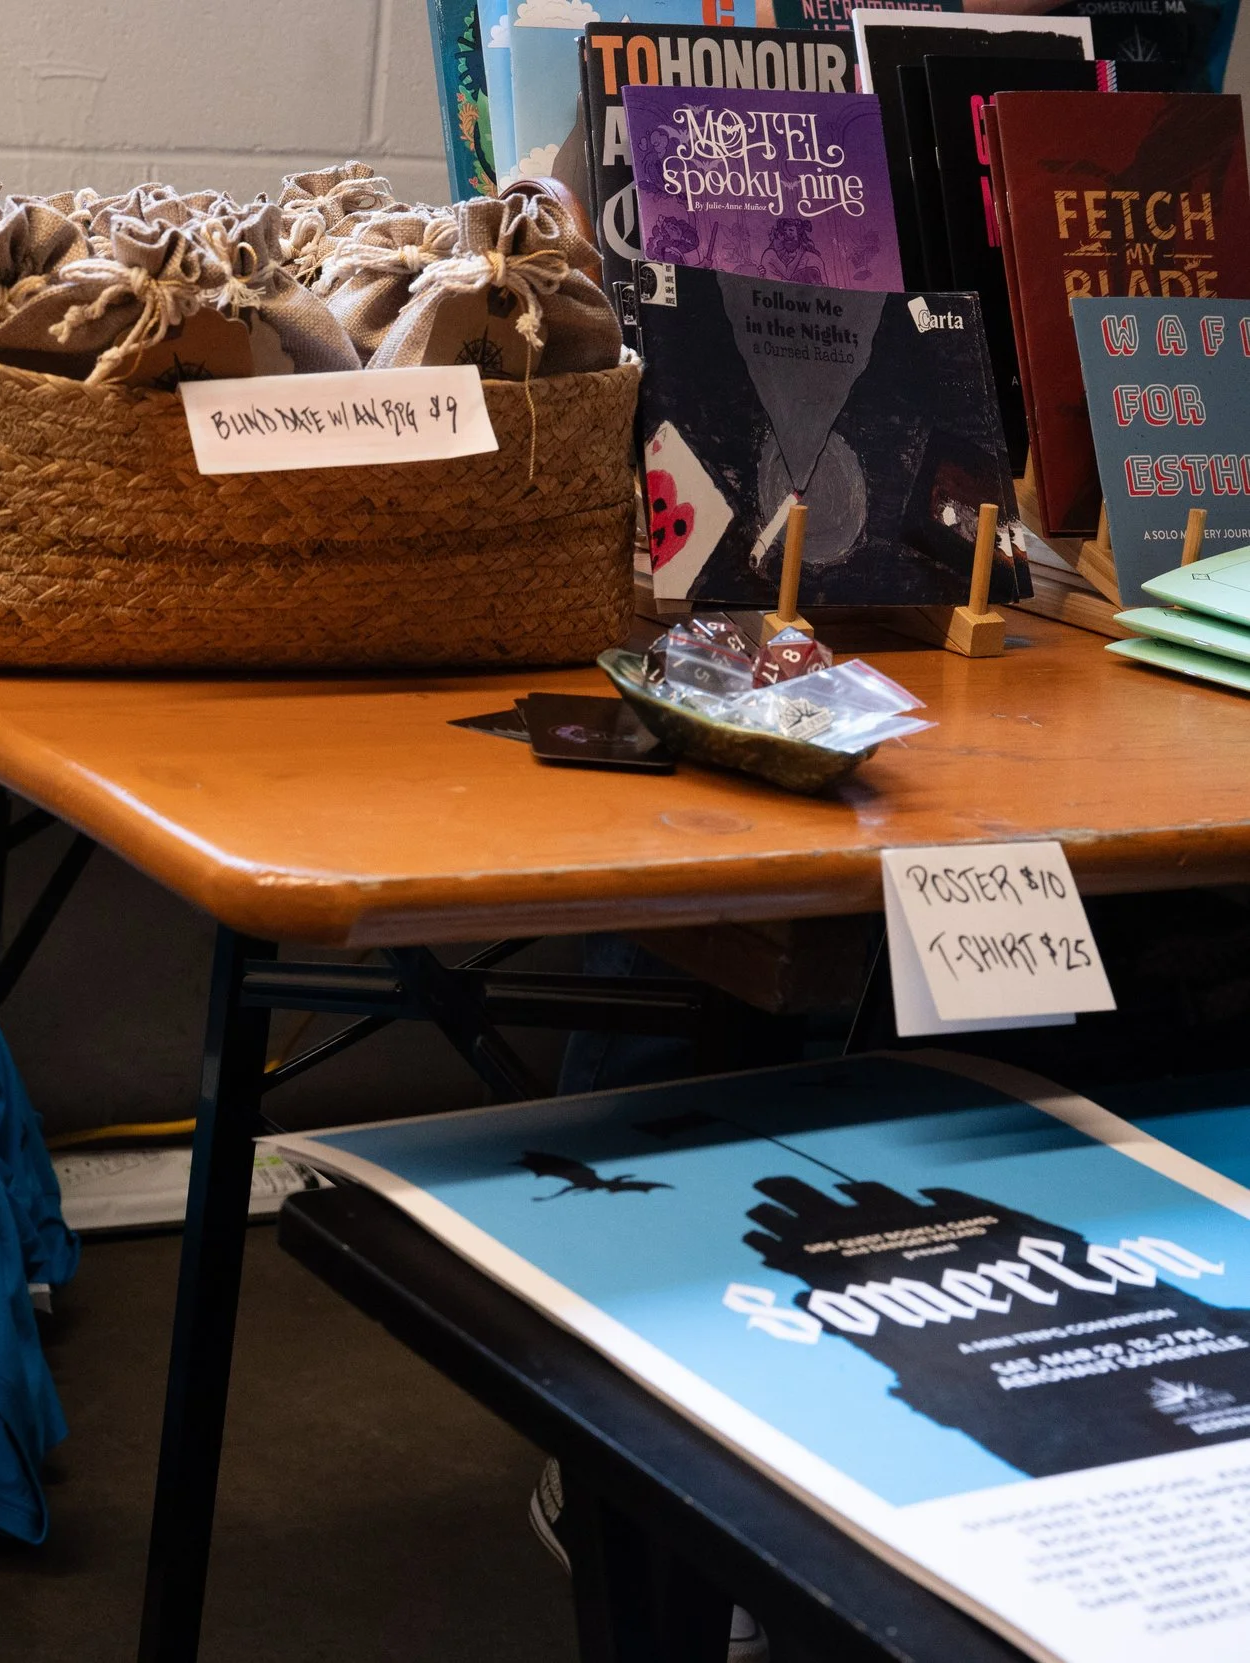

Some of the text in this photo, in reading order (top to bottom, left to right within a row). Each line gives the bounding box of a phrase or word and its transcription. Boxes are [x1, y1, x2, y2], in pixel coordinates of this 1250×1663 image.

[1165, 1, 1187, 14] MA
[673, 108, 845, 167] MOTEL
[663, 155, 865, 217] spooky nine
[705, 202, 742, 211] Julie-Anne
[743, 202, 767, 211] Muñoz
[1053, 190, 1215, 241] FETCH
[1125, 242, 1157, 265] MY
[752, 290, 844, 317] Follow Me
[746, 315, 762, 334] in
[767, 318, 796, 338] the
[918, 308, 964, 330] Carta
[753, 341, 855, 364] a Cursed Radio
[1113, 384, 1206, 426] FOR
[211, 403, 279, 440] BLIND
[278, 407, 326, 434] DATE
[352, 398, 385, 429] AN
[382, 399, 418, 437] RPG
[1144, 530, 1151, 540] A
[1152, 530, 1178, 540] SOLO
[781, 648, 801, 663] 8
[906, 865, 1067, 905] POSTER $10
[929, 931, 1092, 982] T-SHIRT $25
[722, 1235, 1225, 1344] SomerCon
